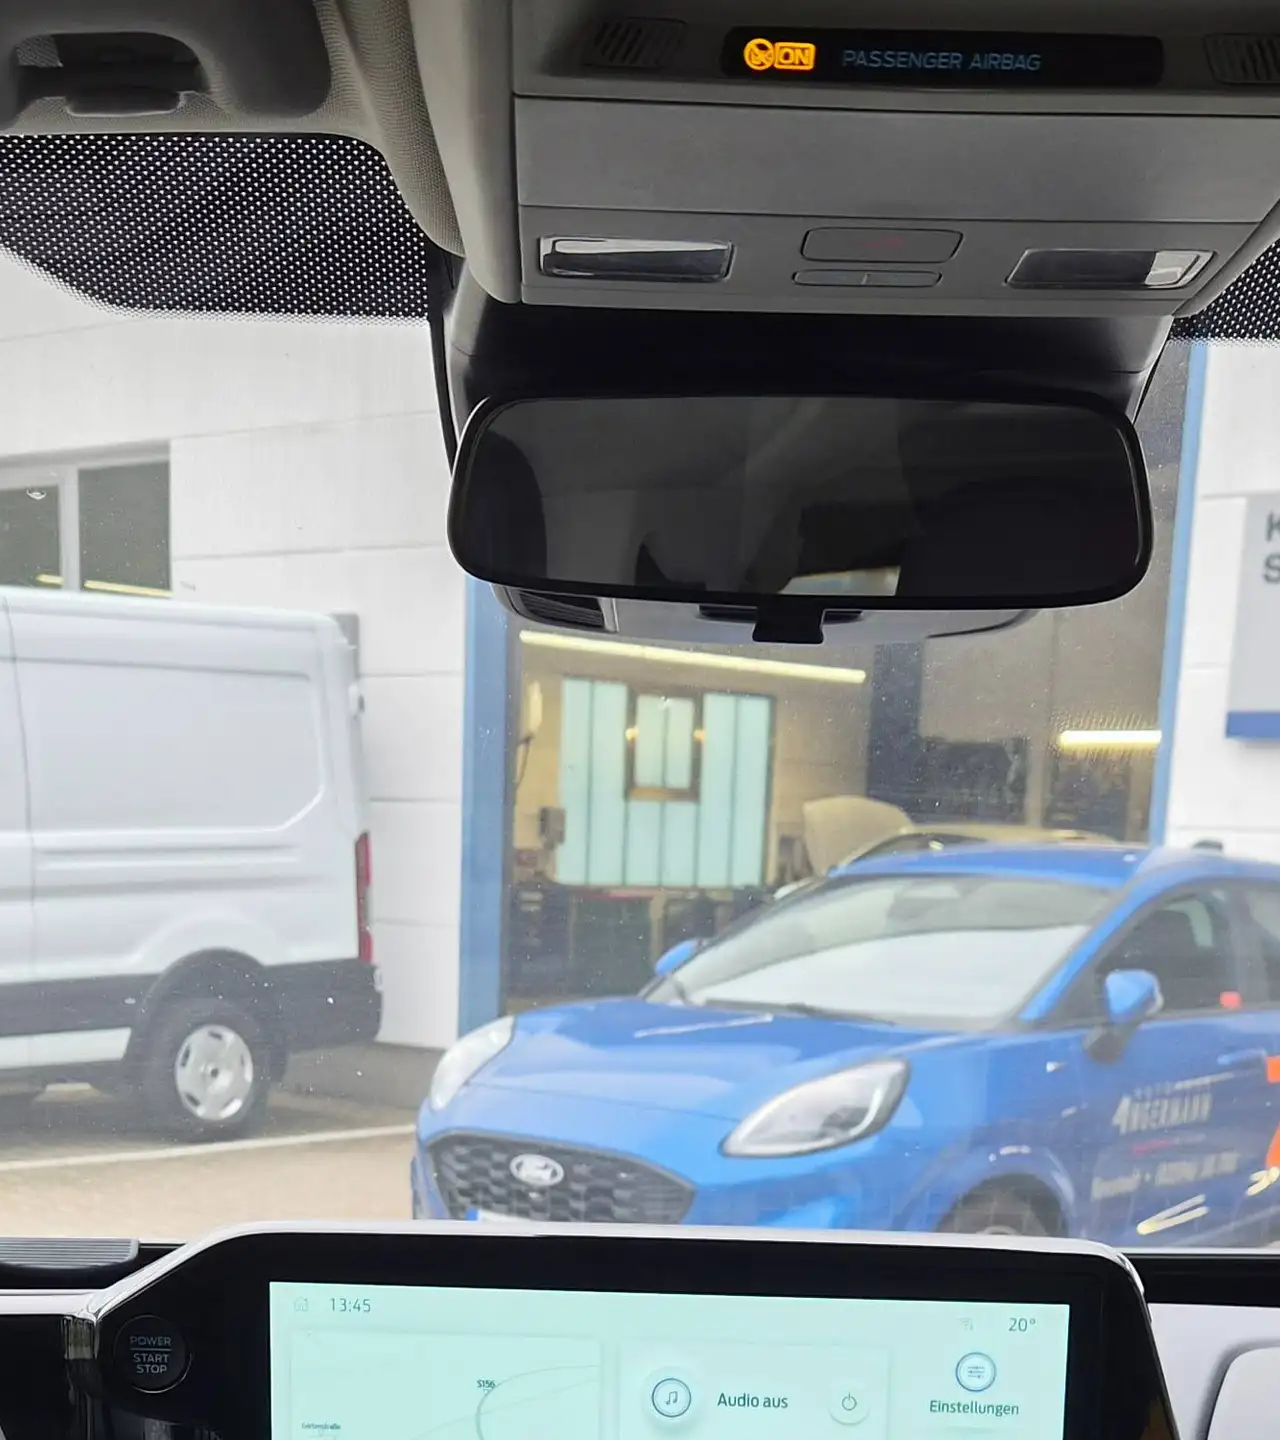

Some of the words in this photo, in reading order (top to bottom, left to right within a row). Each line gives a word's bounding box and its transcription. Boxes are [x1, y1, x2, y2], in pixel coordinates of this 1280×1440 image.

[778, 46, 812, 66] ON
[842, 50, 962, 71] PASSENGER
[969, 51, 1041, 71] AIRBAG
[329, 1298, 371, 1313] 13:45
[1008, 1317, 1037, 1332] 20°
[129, 1336, 172, 1346] POWER
[133, 1353, 170, 1363] START
[136, 1364, 168, 1373] STOP
[476, 1380, 496, 1389] S156
[717, 1392, 759, 1409] Audio
[762, 1397, 788, 1409] aus
[929, 1400, 1020, 1417] Einstellungen
